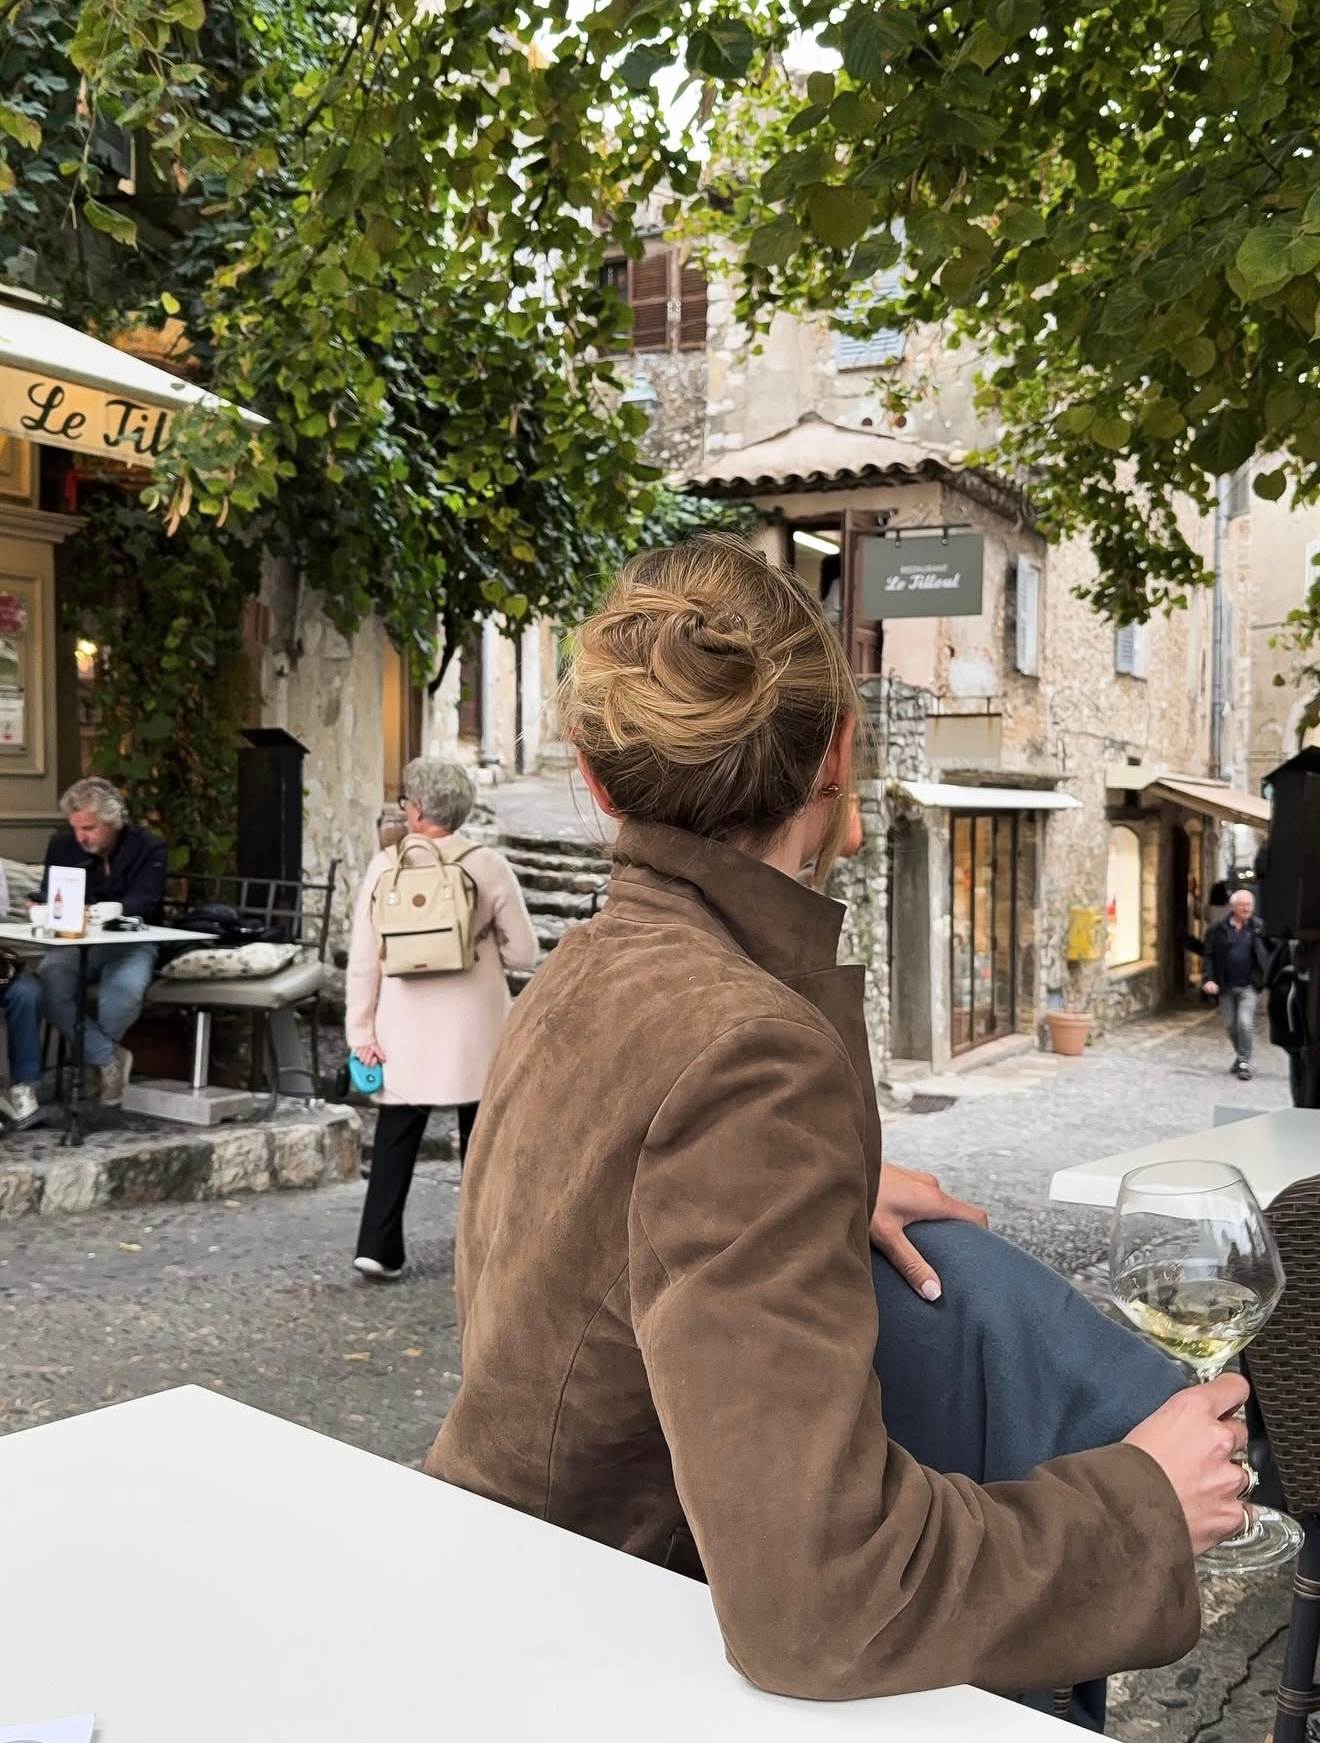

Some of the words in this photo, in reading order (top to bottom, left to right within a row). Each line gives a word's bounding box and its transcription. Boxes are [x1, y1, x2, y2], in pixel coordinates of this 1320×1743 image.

[20, 382, 86, 439] Le
[103, 400, 170, 457] Til
[884, 575, 906, 591] Le
